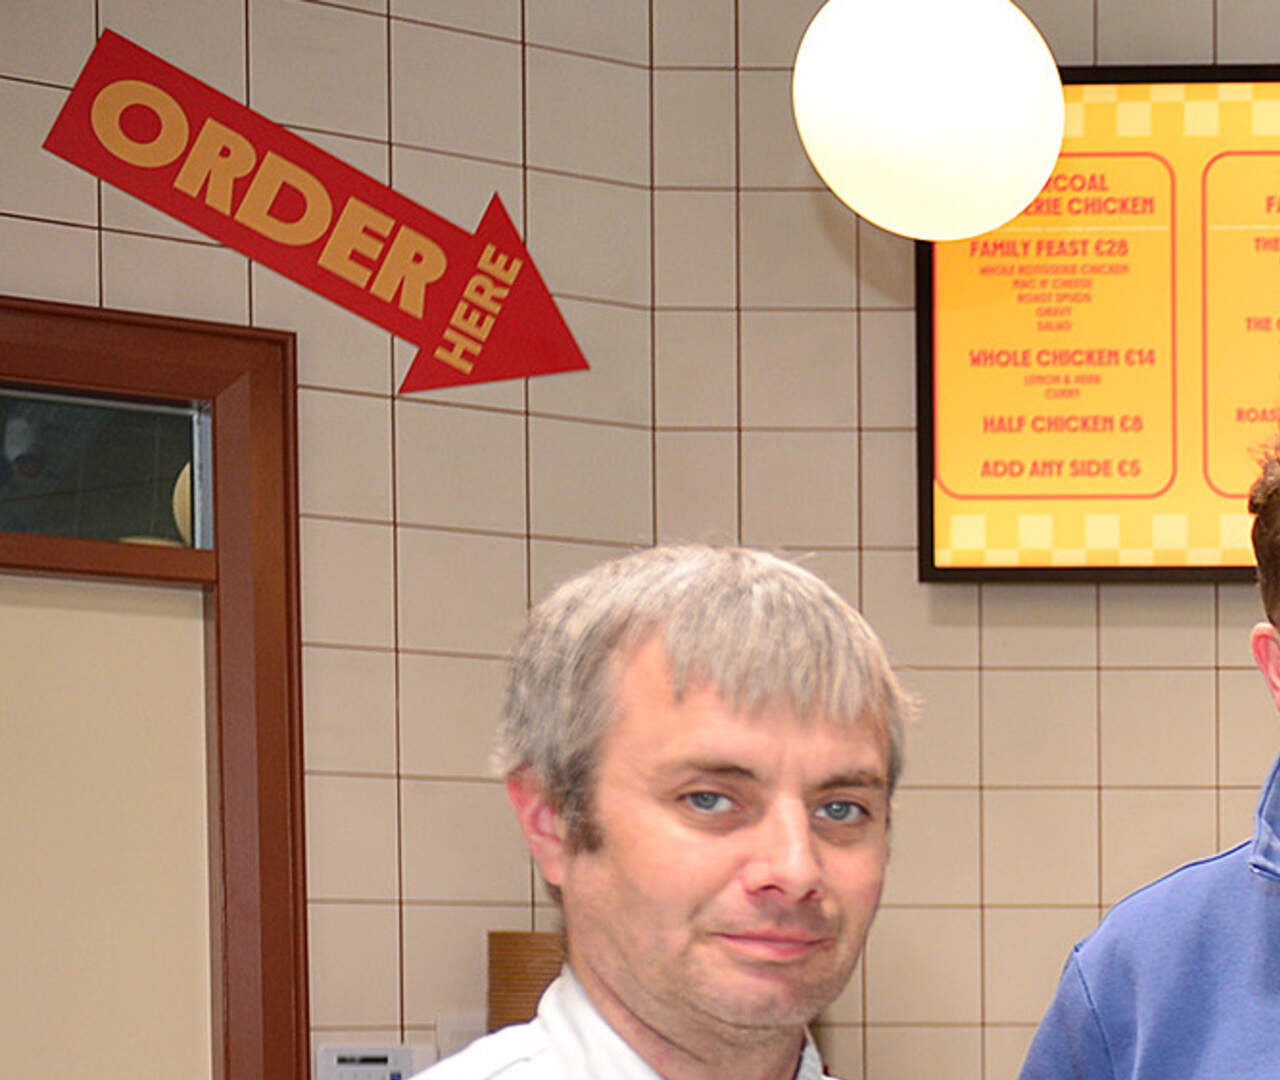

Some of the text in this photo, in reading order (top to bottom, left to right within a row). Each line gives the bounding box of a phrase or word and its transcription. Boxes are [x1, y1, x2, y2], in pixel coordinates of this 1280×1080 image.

[1041, 174, 1109, 192] COAL
[91, 80, 447, 319] ORDER
[1067, 197, 1155, 215] CHICKEN
[969, 239, 1129, 257] FAMILY FEAST €28
[1253, 237, 1280, 251] THE
[434, 243, 523, 375] HERE
[1245, 317, 1272, 331] THE
[968, 348, 1156, 367] WHOLE CHICKEN €14
[982, 415, 1144, 433] HALF CHICKEN €8
[980, 459, 1141, 477] ADD ANY SIDE €5
